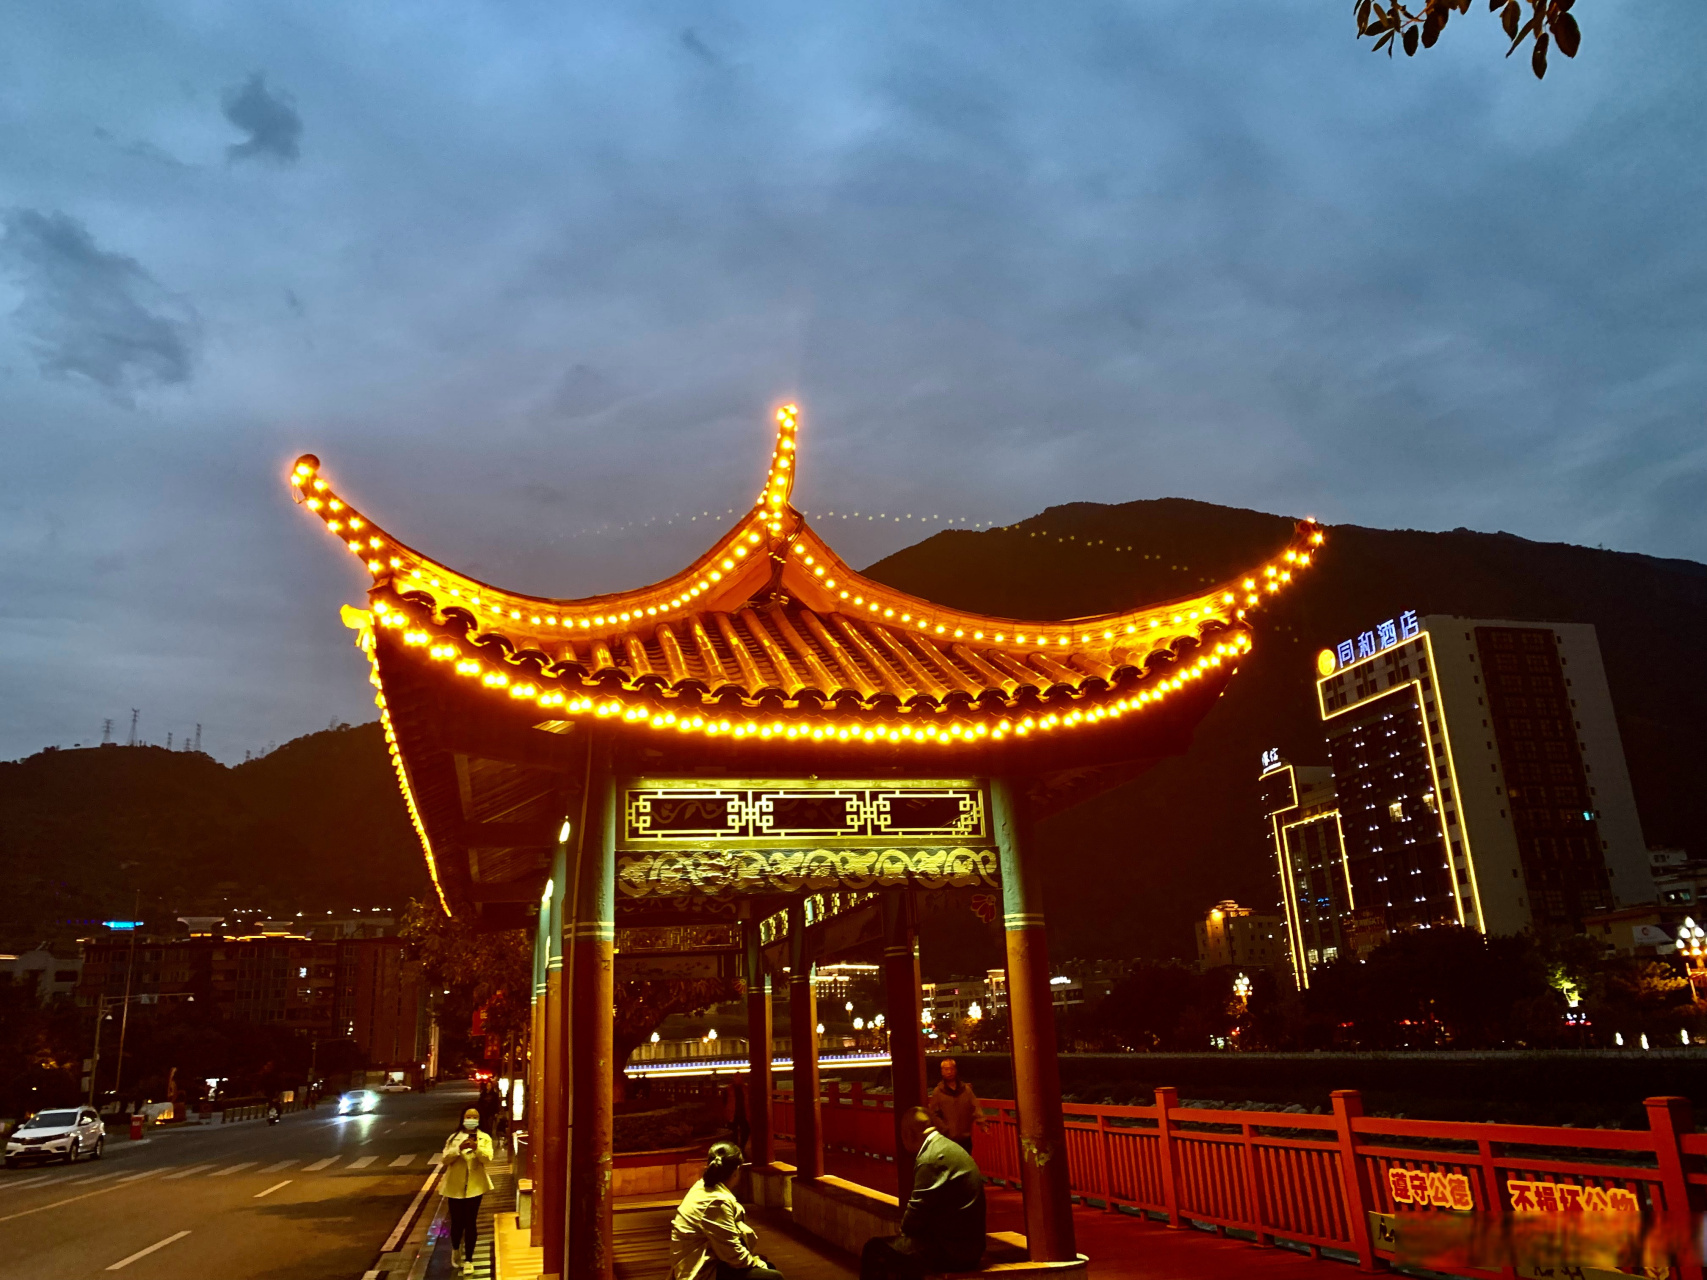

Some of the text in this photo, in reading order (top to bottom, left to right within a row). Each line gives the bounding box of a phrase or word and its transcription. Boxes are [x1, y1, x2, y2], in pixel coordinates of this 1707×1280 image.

[1337, 609, 1419, 668] 同和酒店
[1390, 1169, 1473, 1209] 遵守公德
